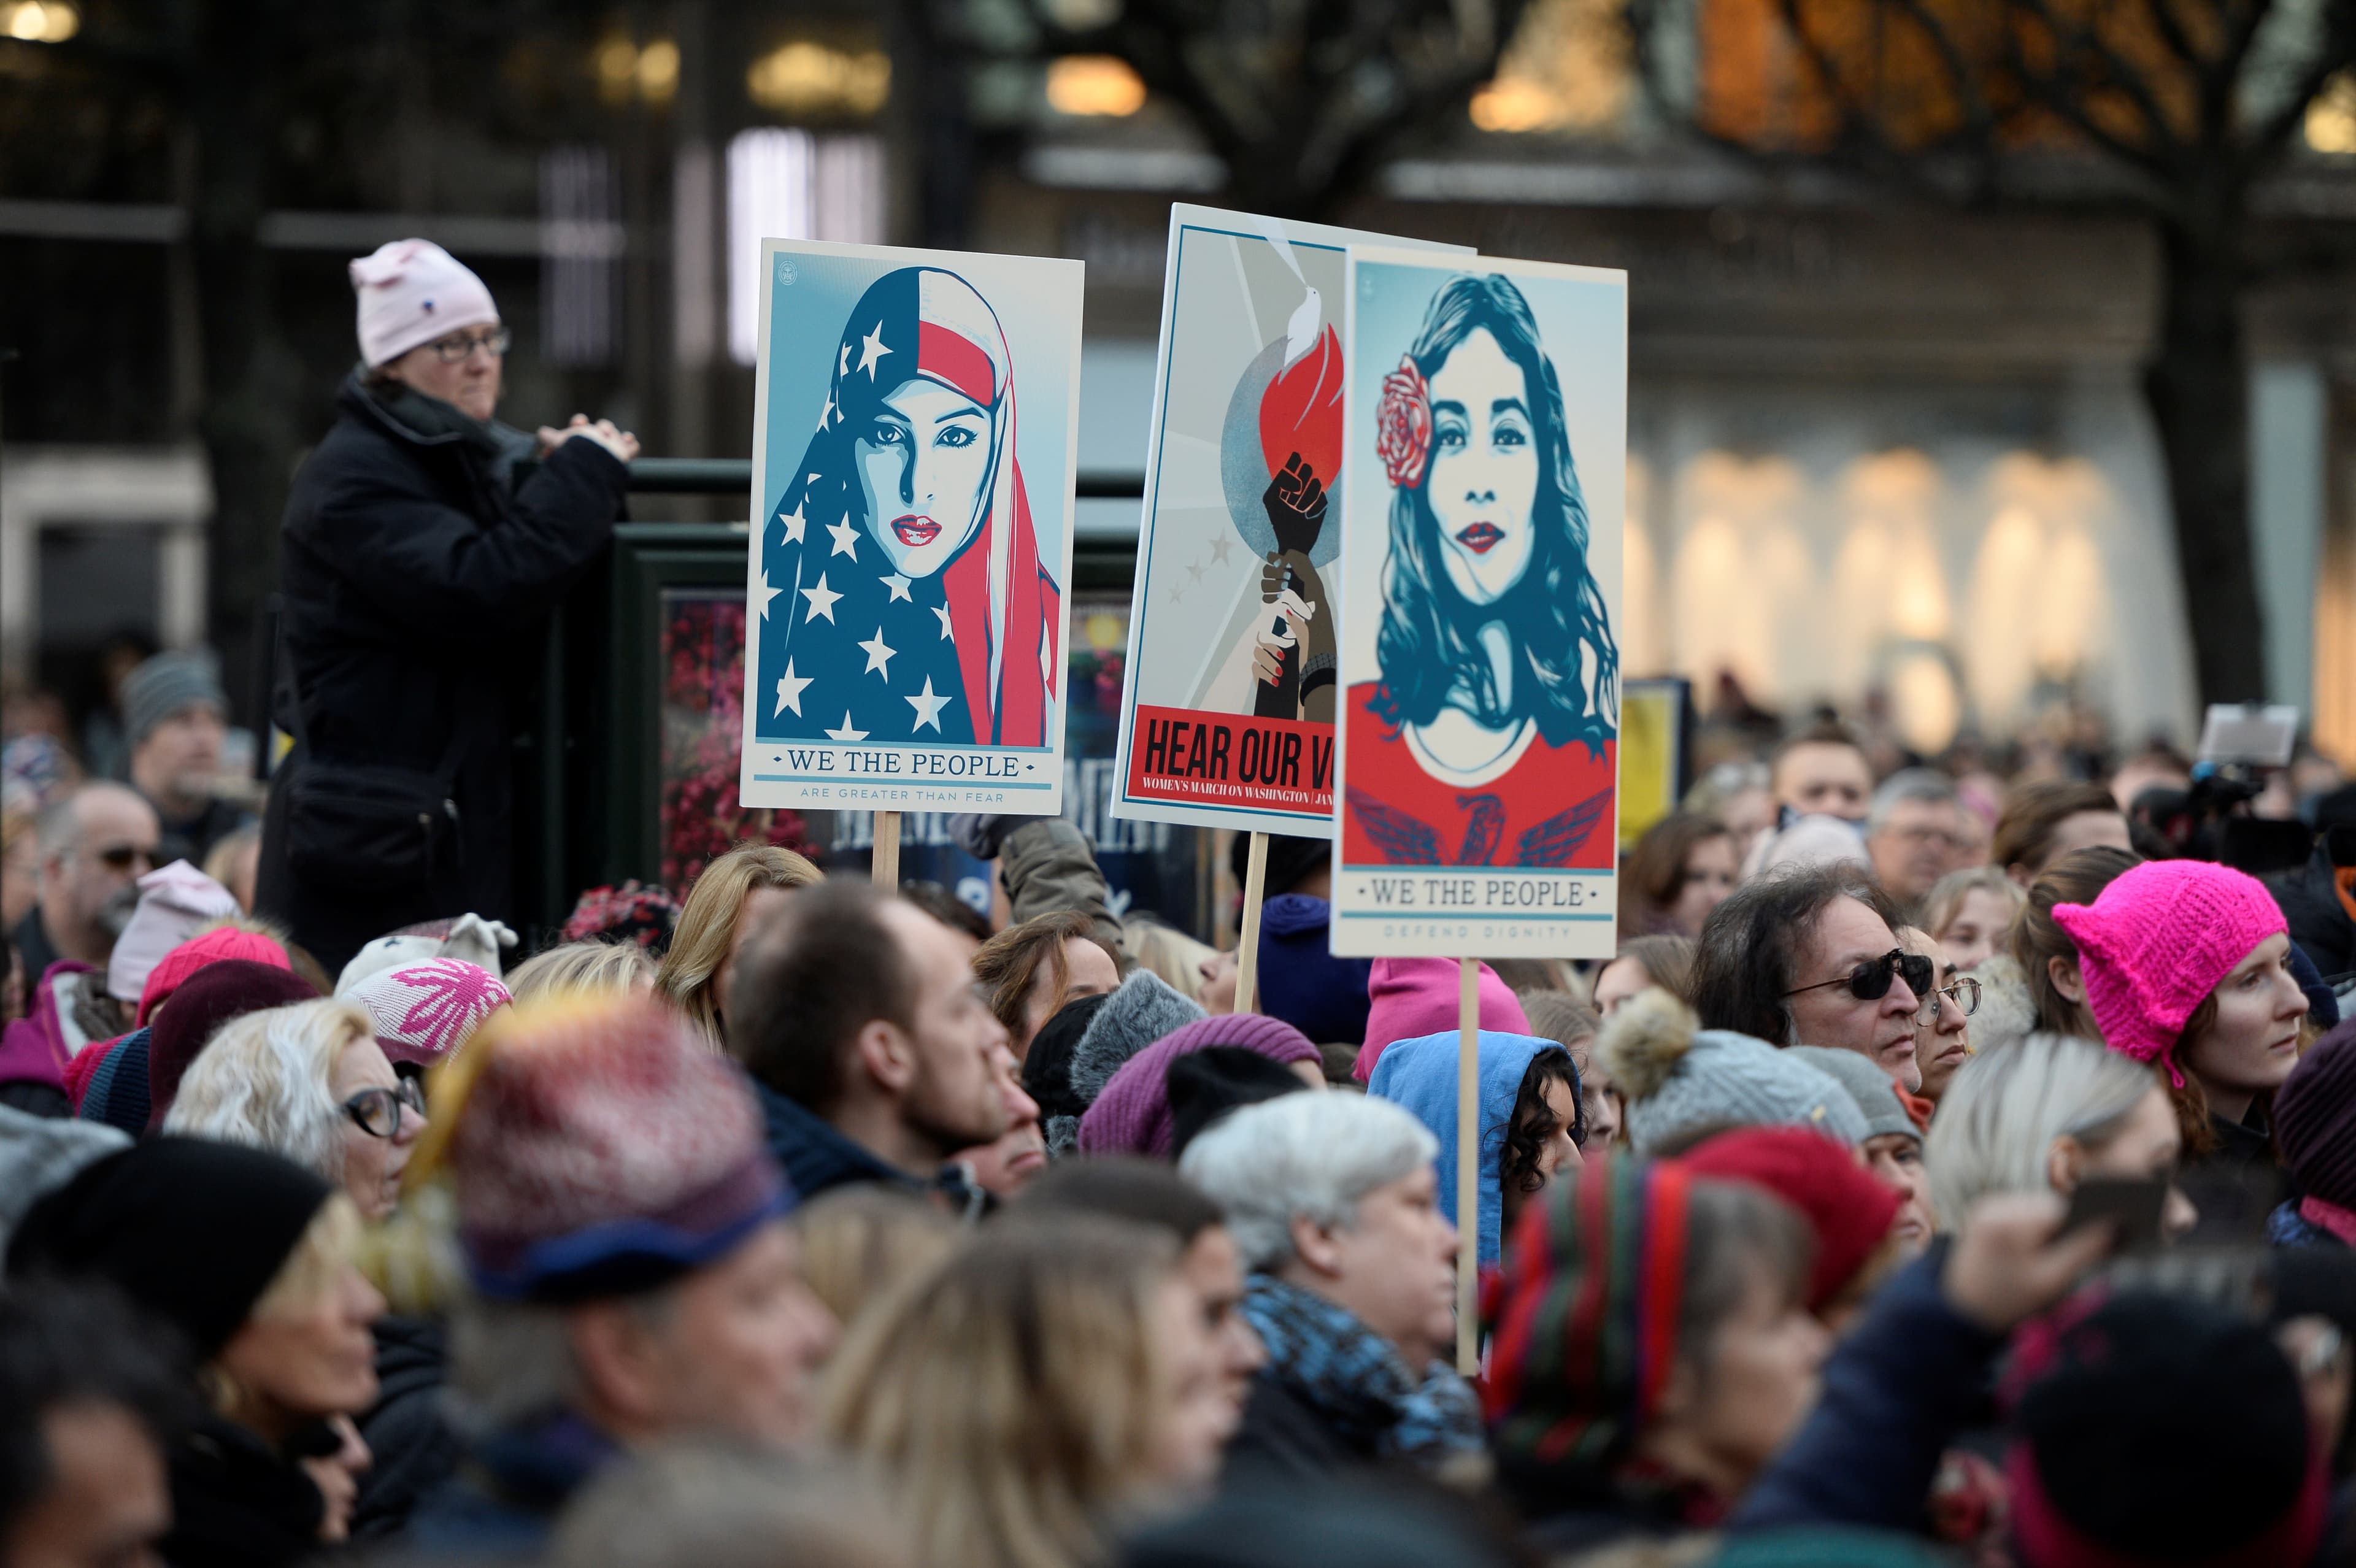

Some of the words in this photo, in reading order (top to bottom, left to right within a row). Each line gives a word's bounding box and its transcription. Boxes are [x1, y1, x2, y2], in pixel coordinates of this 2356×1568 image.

[787, 750, 835, 771] WE
[844, 751, 901, 774] THE
[911, 753, 1020, 777] PEOPLE
[1144, 718, 1231, 780] HEAR
[1238, 728, 1302, 788] OUR
[1312, 735, 1334, 790] V
[801, 788, 830, 797] ARE
[839, 789, 908, 800] GREATER
[916, 791, 957, 801] THAN
[966, 793, 1003, 803] FEAR
[1142, 777, 1188, 792] WOMEN'S
[1190, 780, 1227, 796] MARCH
[1228, 784, 1243, 797] ON
[1245, 786, 1309, 804] WASHINGTON
[1371, 878, 1415, 905] WE
[1422, 879, 1477, 905] THE
[1485, 880, 1584, 907] PEOPLE
[1384, 925, 1469, 938] DEFEND
[1483, 926, 1571, 939] DIGNITY
